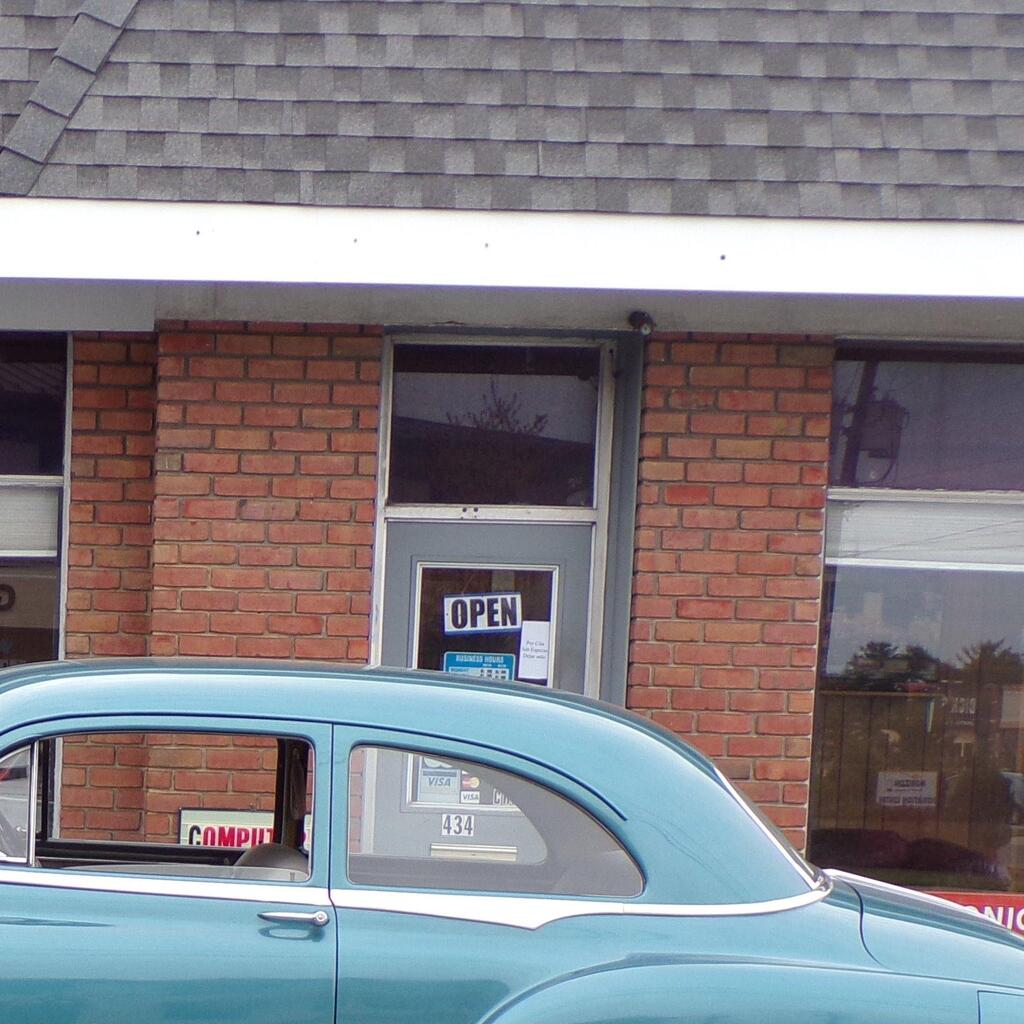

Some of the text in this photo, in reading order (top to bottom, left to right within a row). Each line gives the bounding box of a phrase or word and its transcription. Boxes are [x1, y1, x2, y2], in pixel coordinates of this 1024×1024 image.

[451, 597, 517, 629] OPEN
[428, 777, 451, 787] VISA
[443, 815, 473, 835] 434
